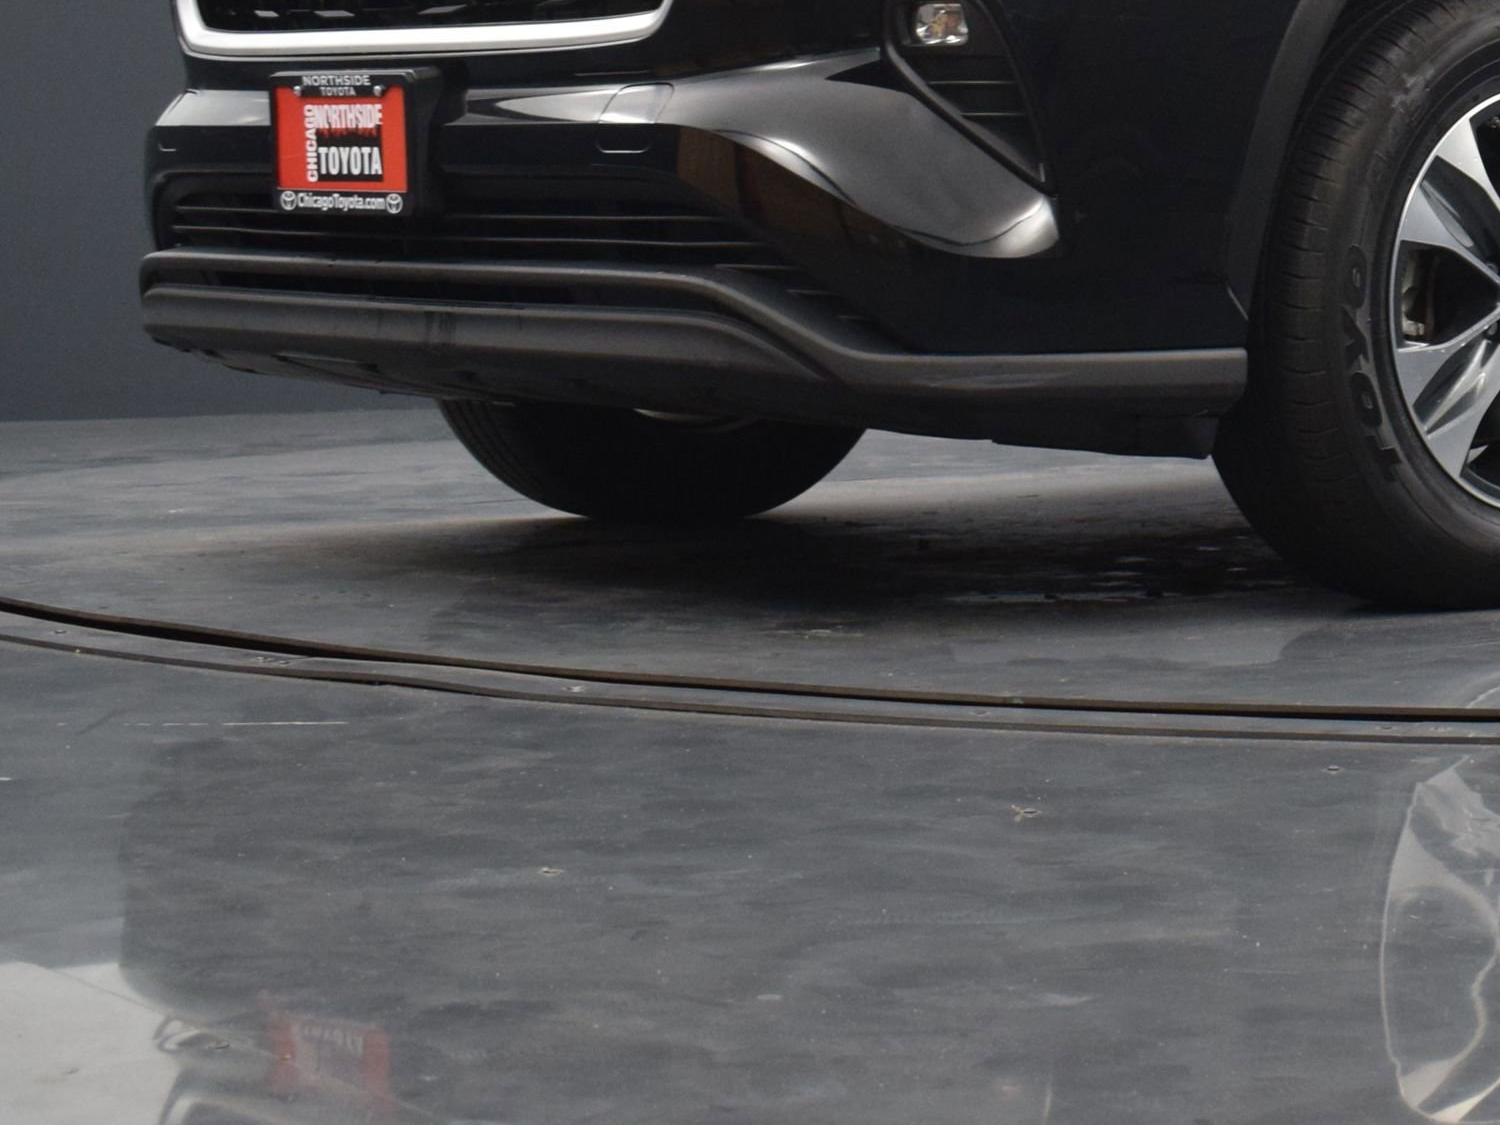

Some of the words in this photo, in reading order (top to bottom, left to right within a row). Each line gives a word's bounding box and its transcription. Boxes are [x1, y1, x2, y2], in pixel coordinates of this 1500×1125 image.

[302, 75, 371, 86] NORTHSIDE
[320, 87, 356, 96] TOYOTA
[314, 104, 383, 129] NORTHSIDE
[304, 104, 318, 183] CHICAGO
[318, 146, 383, 175] TOYOTA
[297, 192, 386, 211] ChicagoToyota.com
